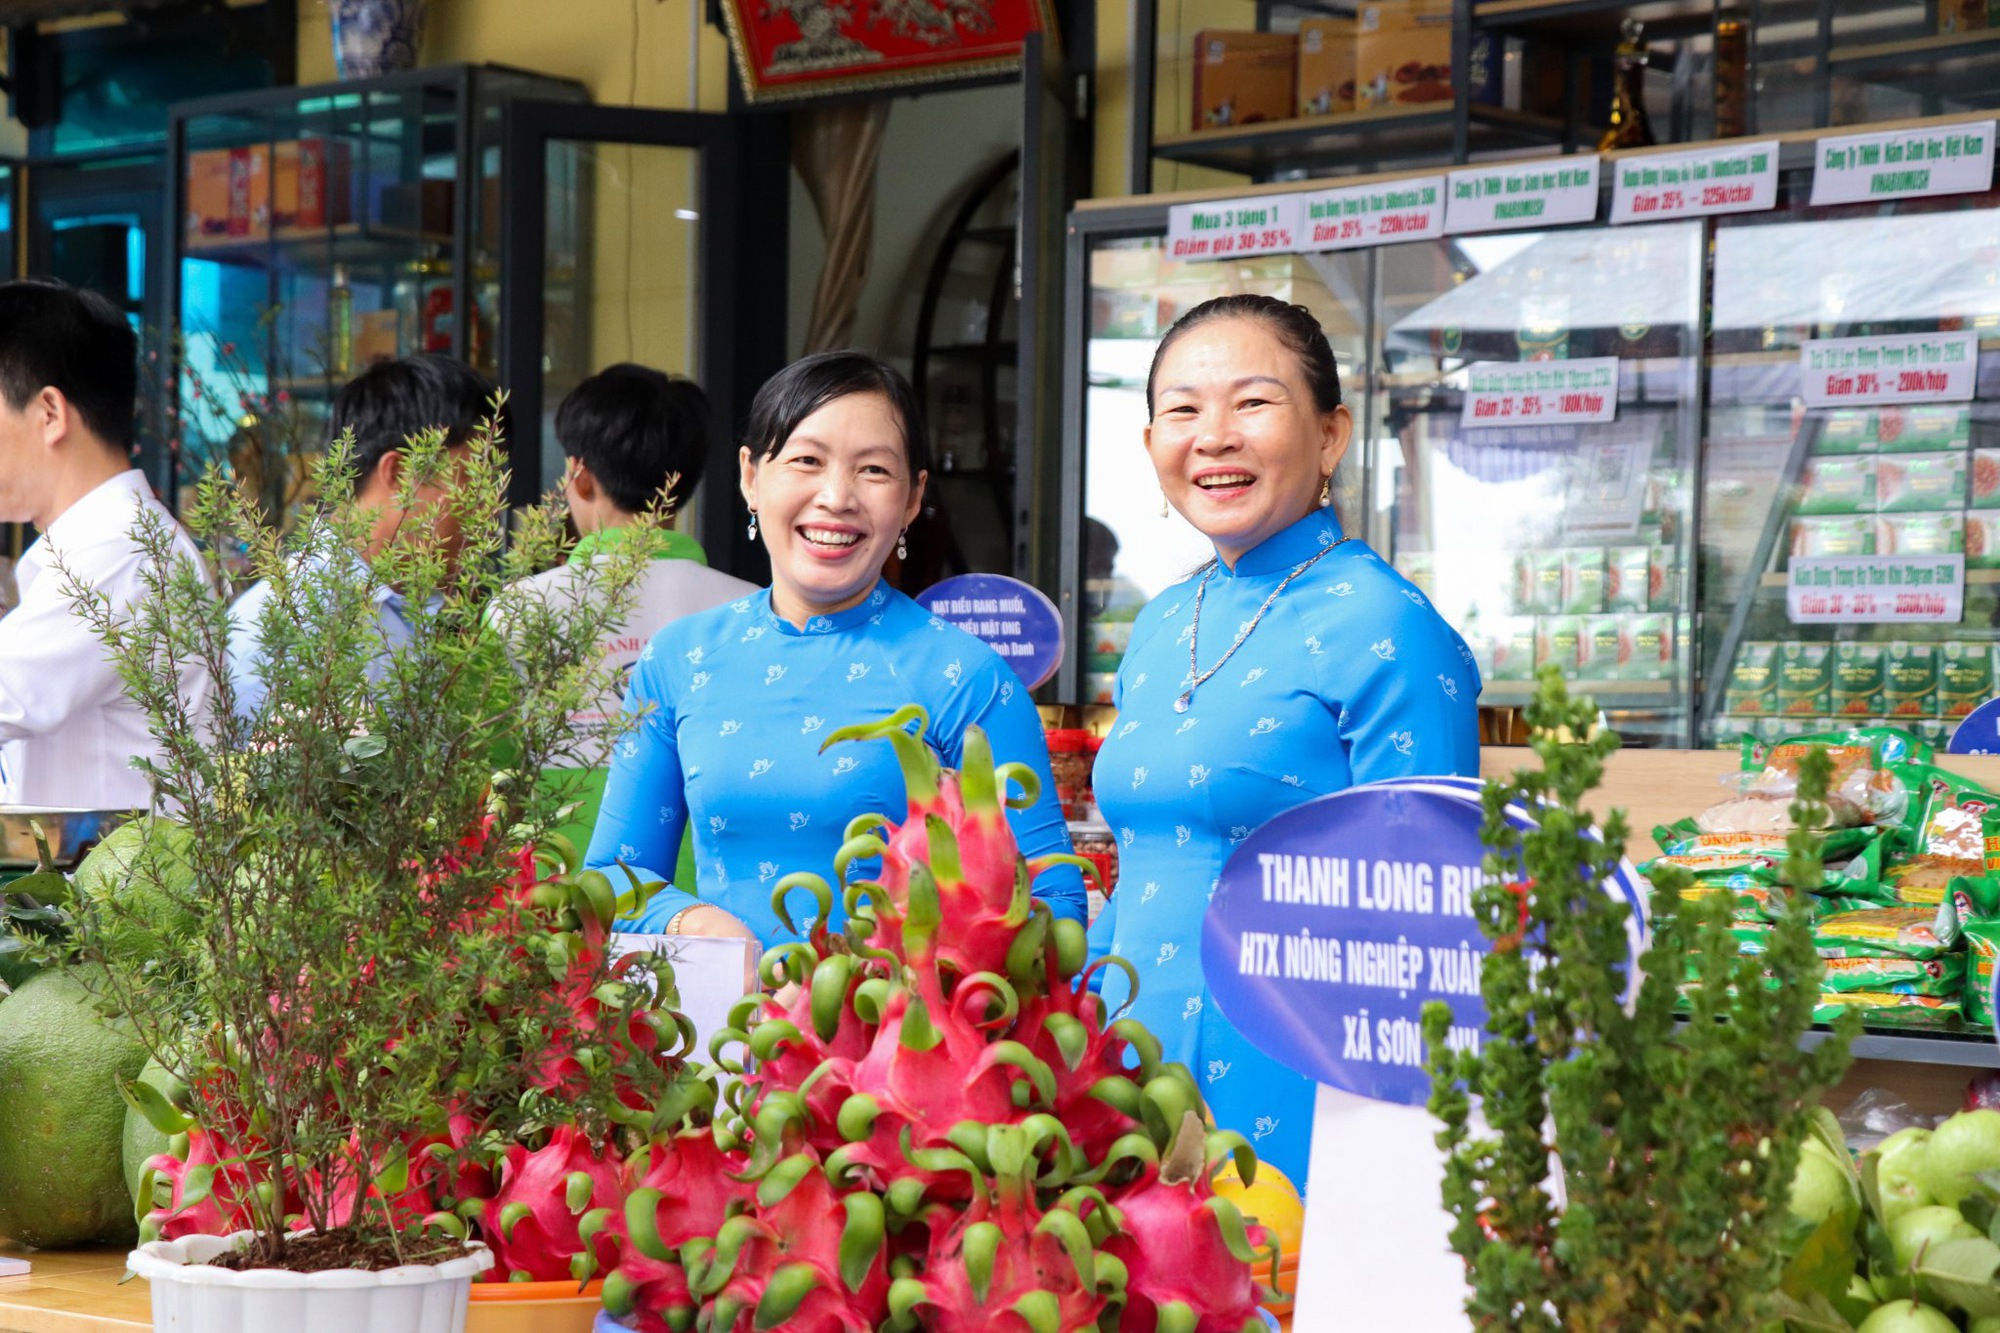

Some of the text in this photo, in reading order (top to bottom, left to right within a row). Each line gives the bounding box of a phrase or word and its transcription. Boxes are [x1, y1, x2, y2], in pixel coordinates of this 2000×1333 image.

[1662, 189, 1684, 210] 35%
[1192, 213, 1221, 231] Mua
[1225, 210, 1233, 227] 3
[1272, 205, 1278, 222] 1
[1341, 219, 1363, 239] 35%
[1174, 228, 1291, 256] Giảm giá 30-35%
[1521, 396, 1542, 415] 35%
[932, 600, 950, 616] HẠT
[973, 599, 998, 614] RANG
[981, 618, 1000, 638] MẬT
[1002, 621, 1021, 636] ONG
[1011, 641, 1034, 656] Danh
[1258, 853, 1349, 908] THANH
[1357, 859, 1433, 915] LONG
[1239, 931, 1280, 978] HTX
[1283, 927, 1342, 983] NÔNG
[1346, 934, 1423, 999] NGHIỆP
[1343, 1008, 1373, 1062] XÃ
[1377, 1016, 1422, 1067] SƠN
